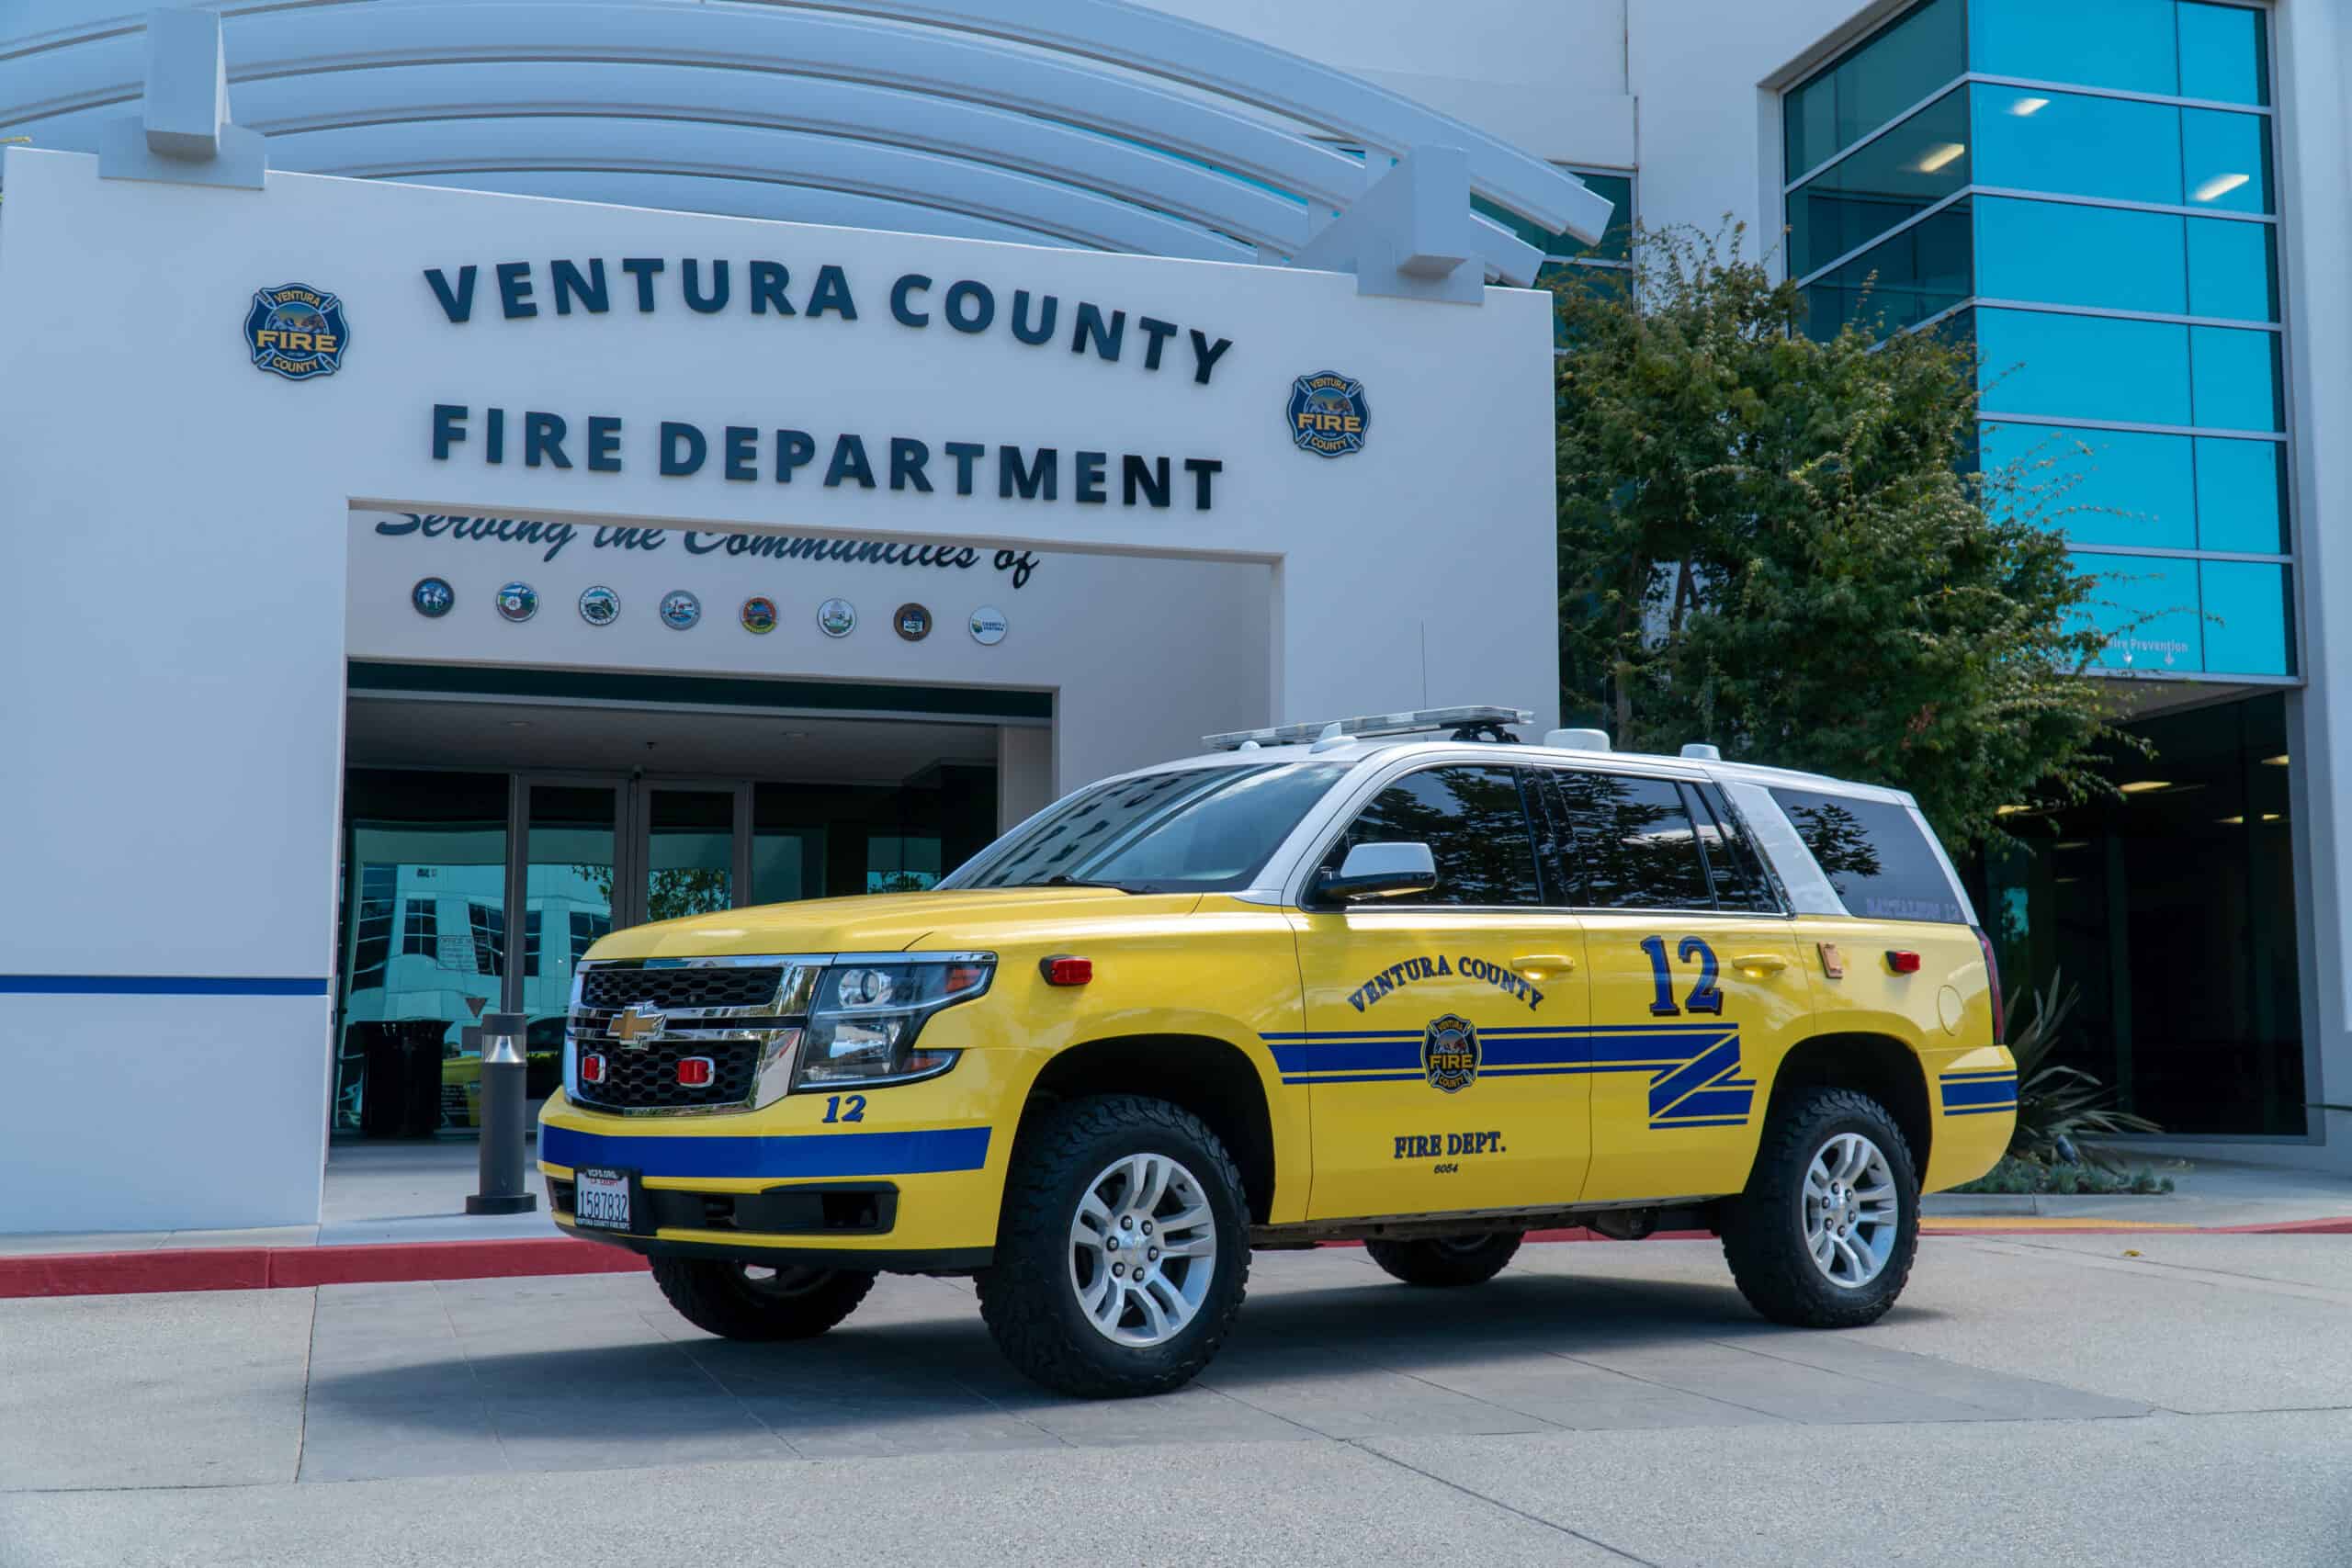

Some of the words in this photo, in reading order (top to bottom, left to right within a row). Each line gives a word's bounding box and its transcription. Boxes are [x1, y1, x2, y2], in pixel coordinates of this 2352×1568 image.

[274, 290, 322, 307] VENTURA
[424, 258, 858, 324] VENTURA
[889, 274, 1234, 386] COUNTY
[256, 330, 339, 353] FIRE
[272, 356, 319, 373] COUNTY
[1298, 413, 1362, 432] FIRE
[432, 403, 622, 474] FIRE
[659, 421, 1223, 512] DEPARTMENT
[1312, 437, 1346, 450] COUNTY
[375, 512, 579, 563] Serving
[683, 528, 981, 570] Communities
[992, 548, 1041, 590] of
[1347, 954, 1453, 1013] VENTURA
[1458, 956, 1544, 1011] COUNTY
[1640, 934, 1724, 1017] 12
[1430, 1055, 1473, 1069] FIRE
[821, 1094, 867, 1123] 12
[1394, 1134, 1442, 1159] FIRE
[1447, 1131, 1507, 1156] DEPT.
[580, 1190, 628, 1222] 1587832
